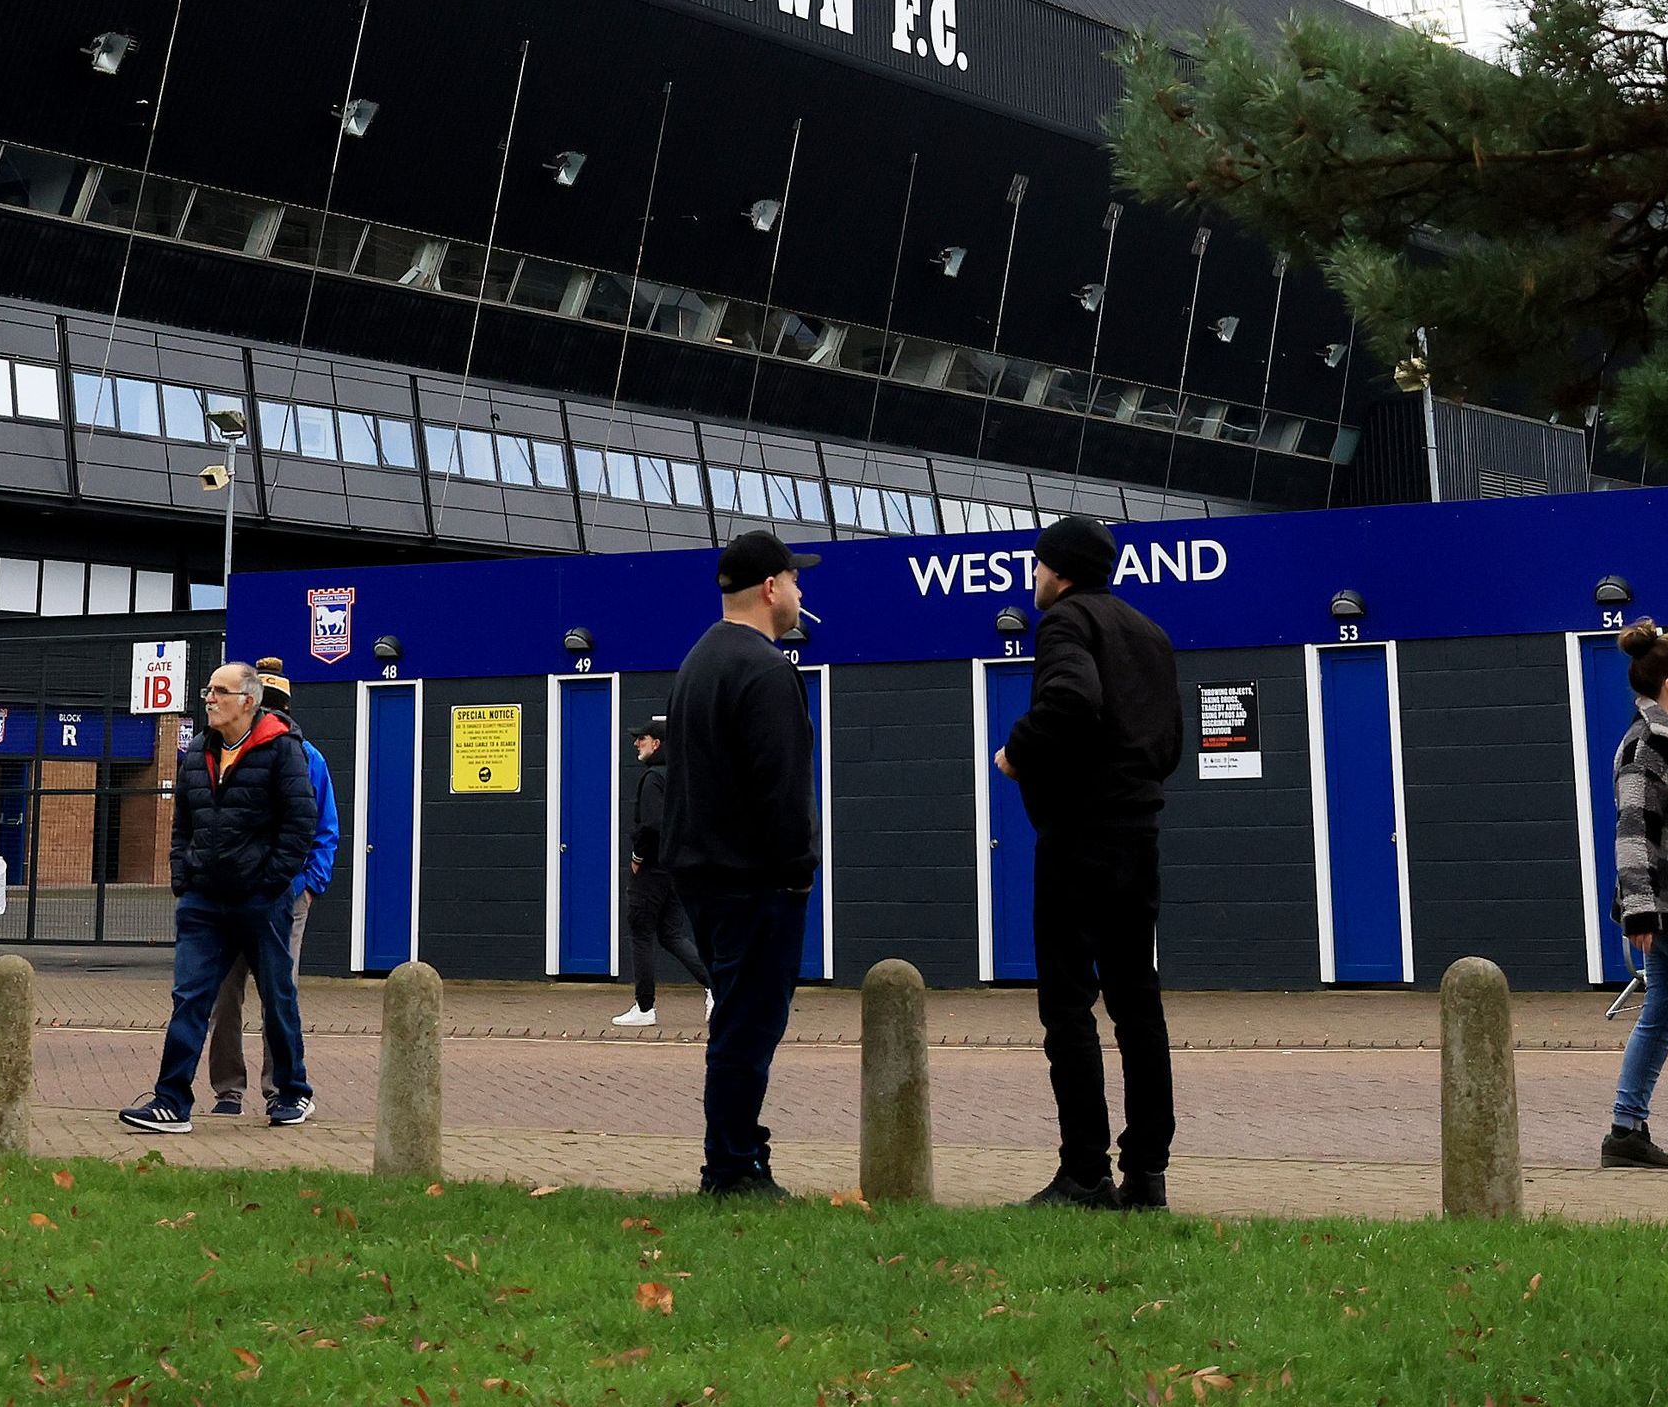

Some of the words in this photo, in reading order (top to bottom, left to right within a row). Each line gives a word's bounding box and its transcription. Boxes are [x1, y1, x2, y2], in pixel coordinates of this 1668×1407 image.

[908, 549, 1036, 596] WEST
[1112, 539, 1228, 586] AND
[1602, 611, 1624, 628] 54
[1339, 624, 1359, 641] 53
[1004, 640, 1022, 657] 51
[147, 662, 172, 672] GATE
[382, 664, 397, 679] 48
[575, 657, 592, 673] 49
[58, 713, 82, 723] BLOCK
[458, 711, 486, 720] SPECIAL
[490, 710, 514, 719] NOTICE
[62, 725, 78, 747] R
